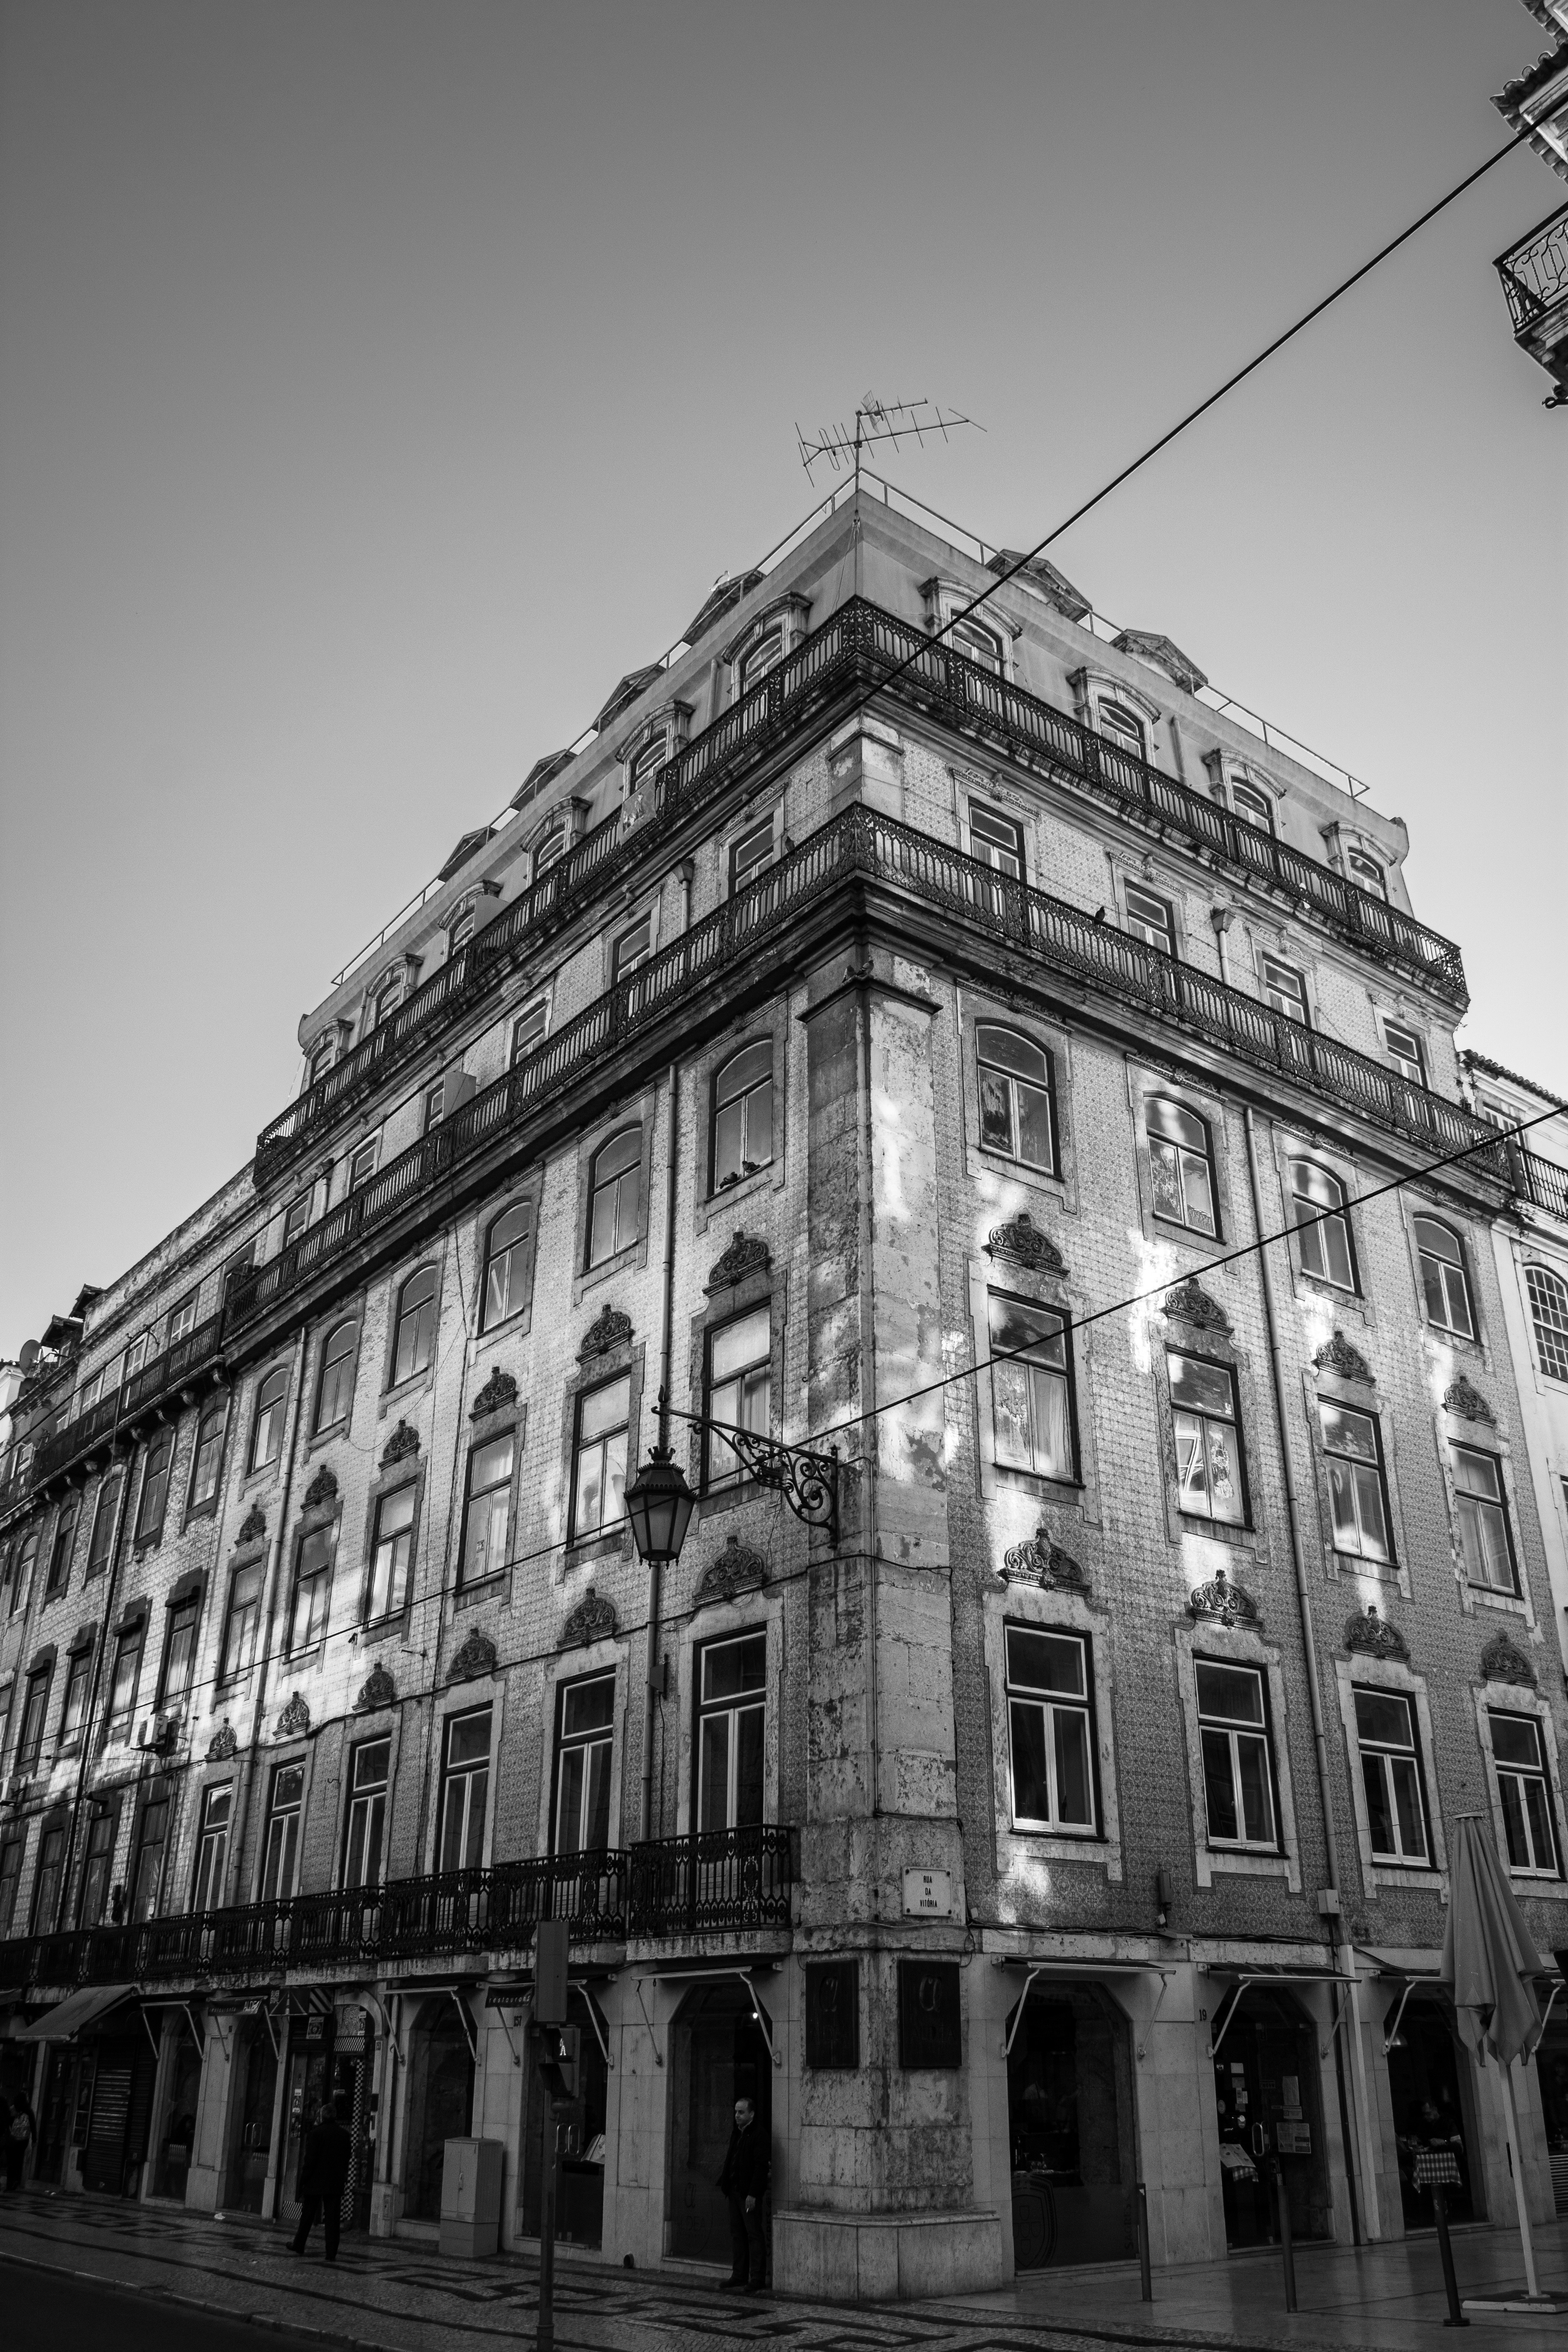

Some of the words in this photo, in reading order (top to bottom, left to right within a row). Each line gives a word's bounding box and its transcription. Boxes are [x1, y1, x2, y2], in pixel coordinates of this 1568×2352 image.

[923, 1875, 932, 1884] RUA
[920, 1898, 937, 1907] VITÓRIA
[1199, 2009, 1207, 2020] 19
